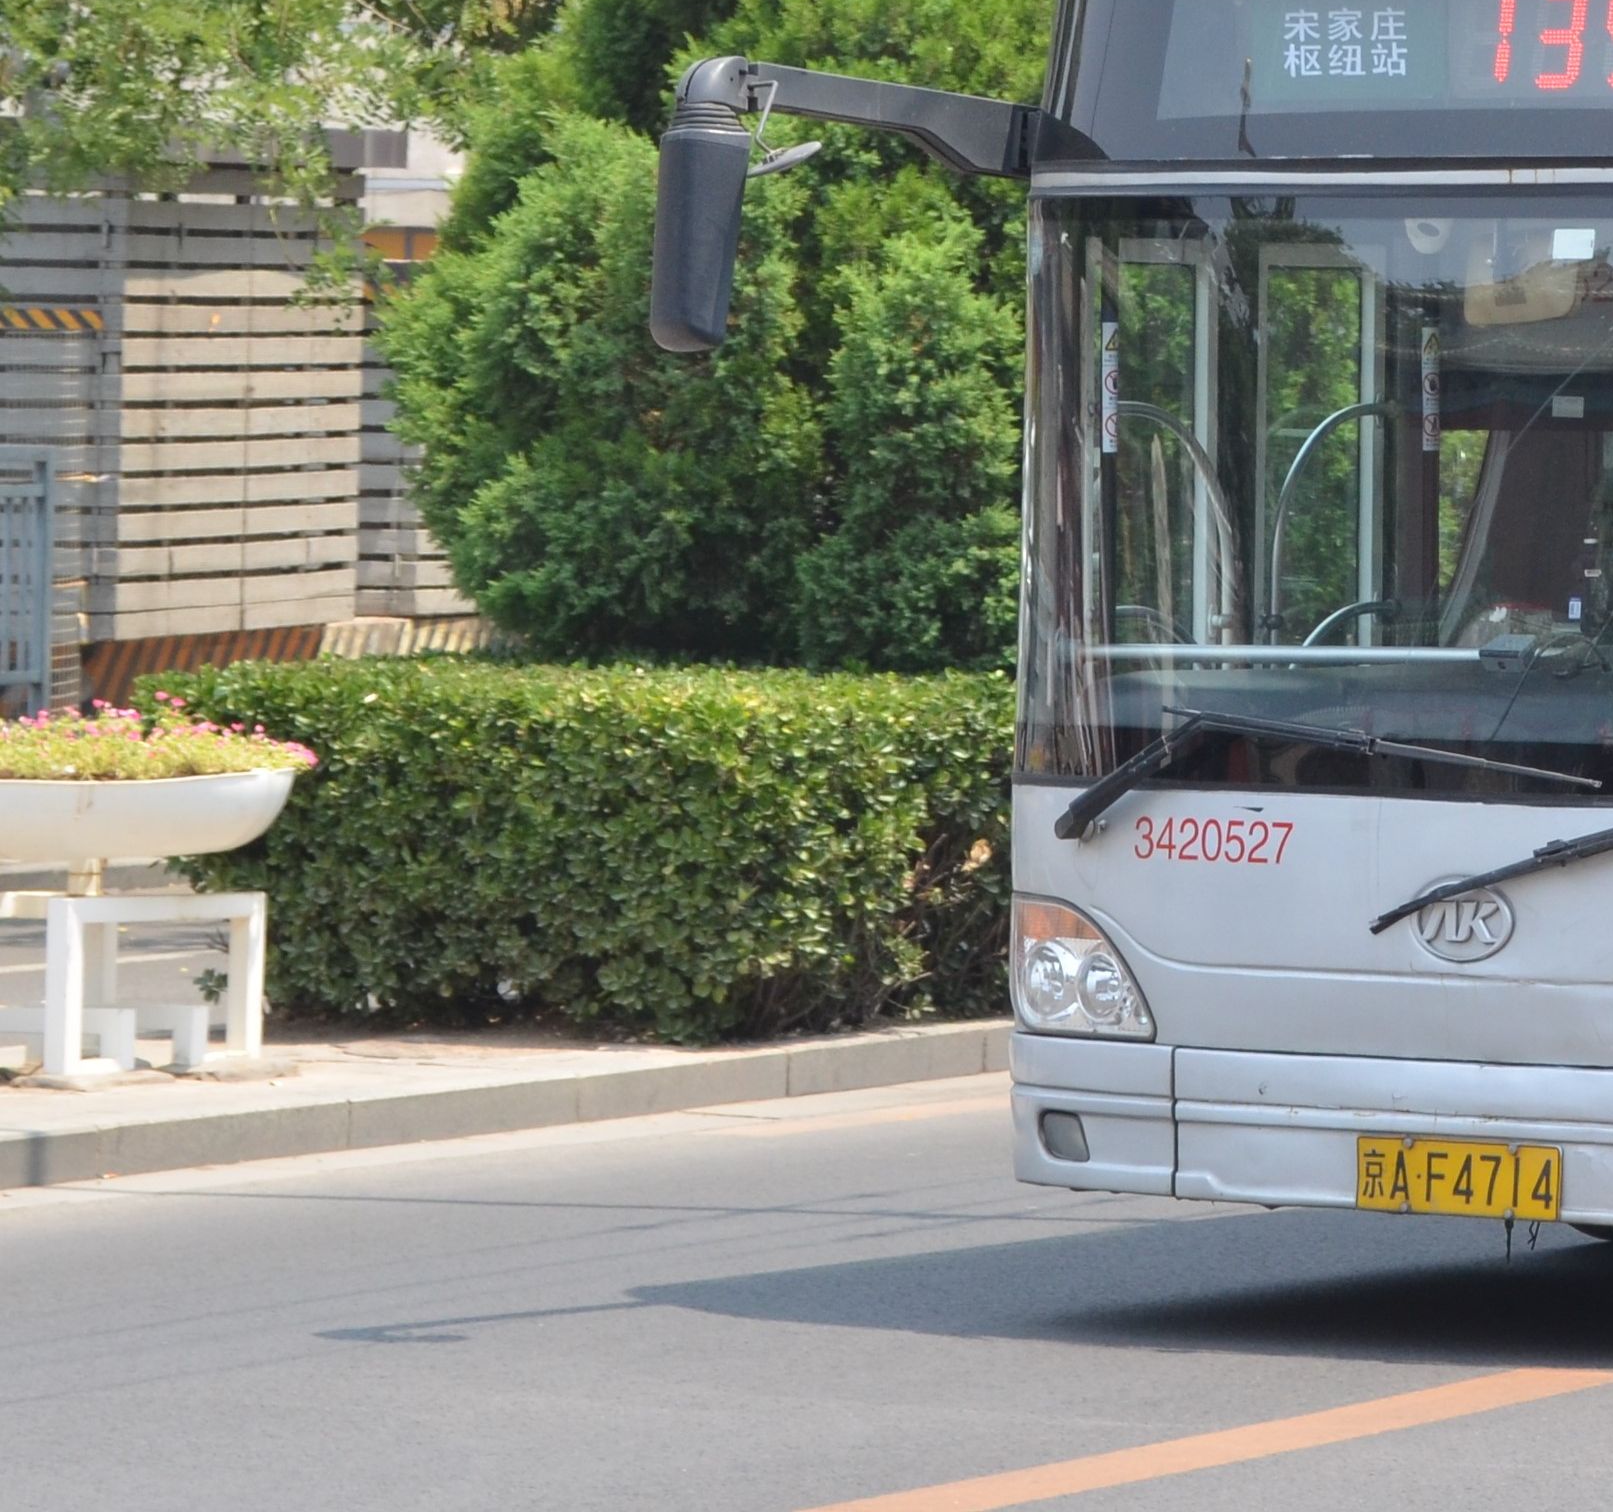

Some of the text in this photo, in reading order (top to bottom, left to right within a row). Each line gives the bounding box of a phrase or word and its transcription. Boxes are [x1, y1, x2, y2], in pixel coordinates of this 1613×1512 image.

[1283, 7, 1408, 42] 宋家庄
[1283, 43, 1408, 78] 枢纽站
[1133, 816, 1295, 865] 3420527
